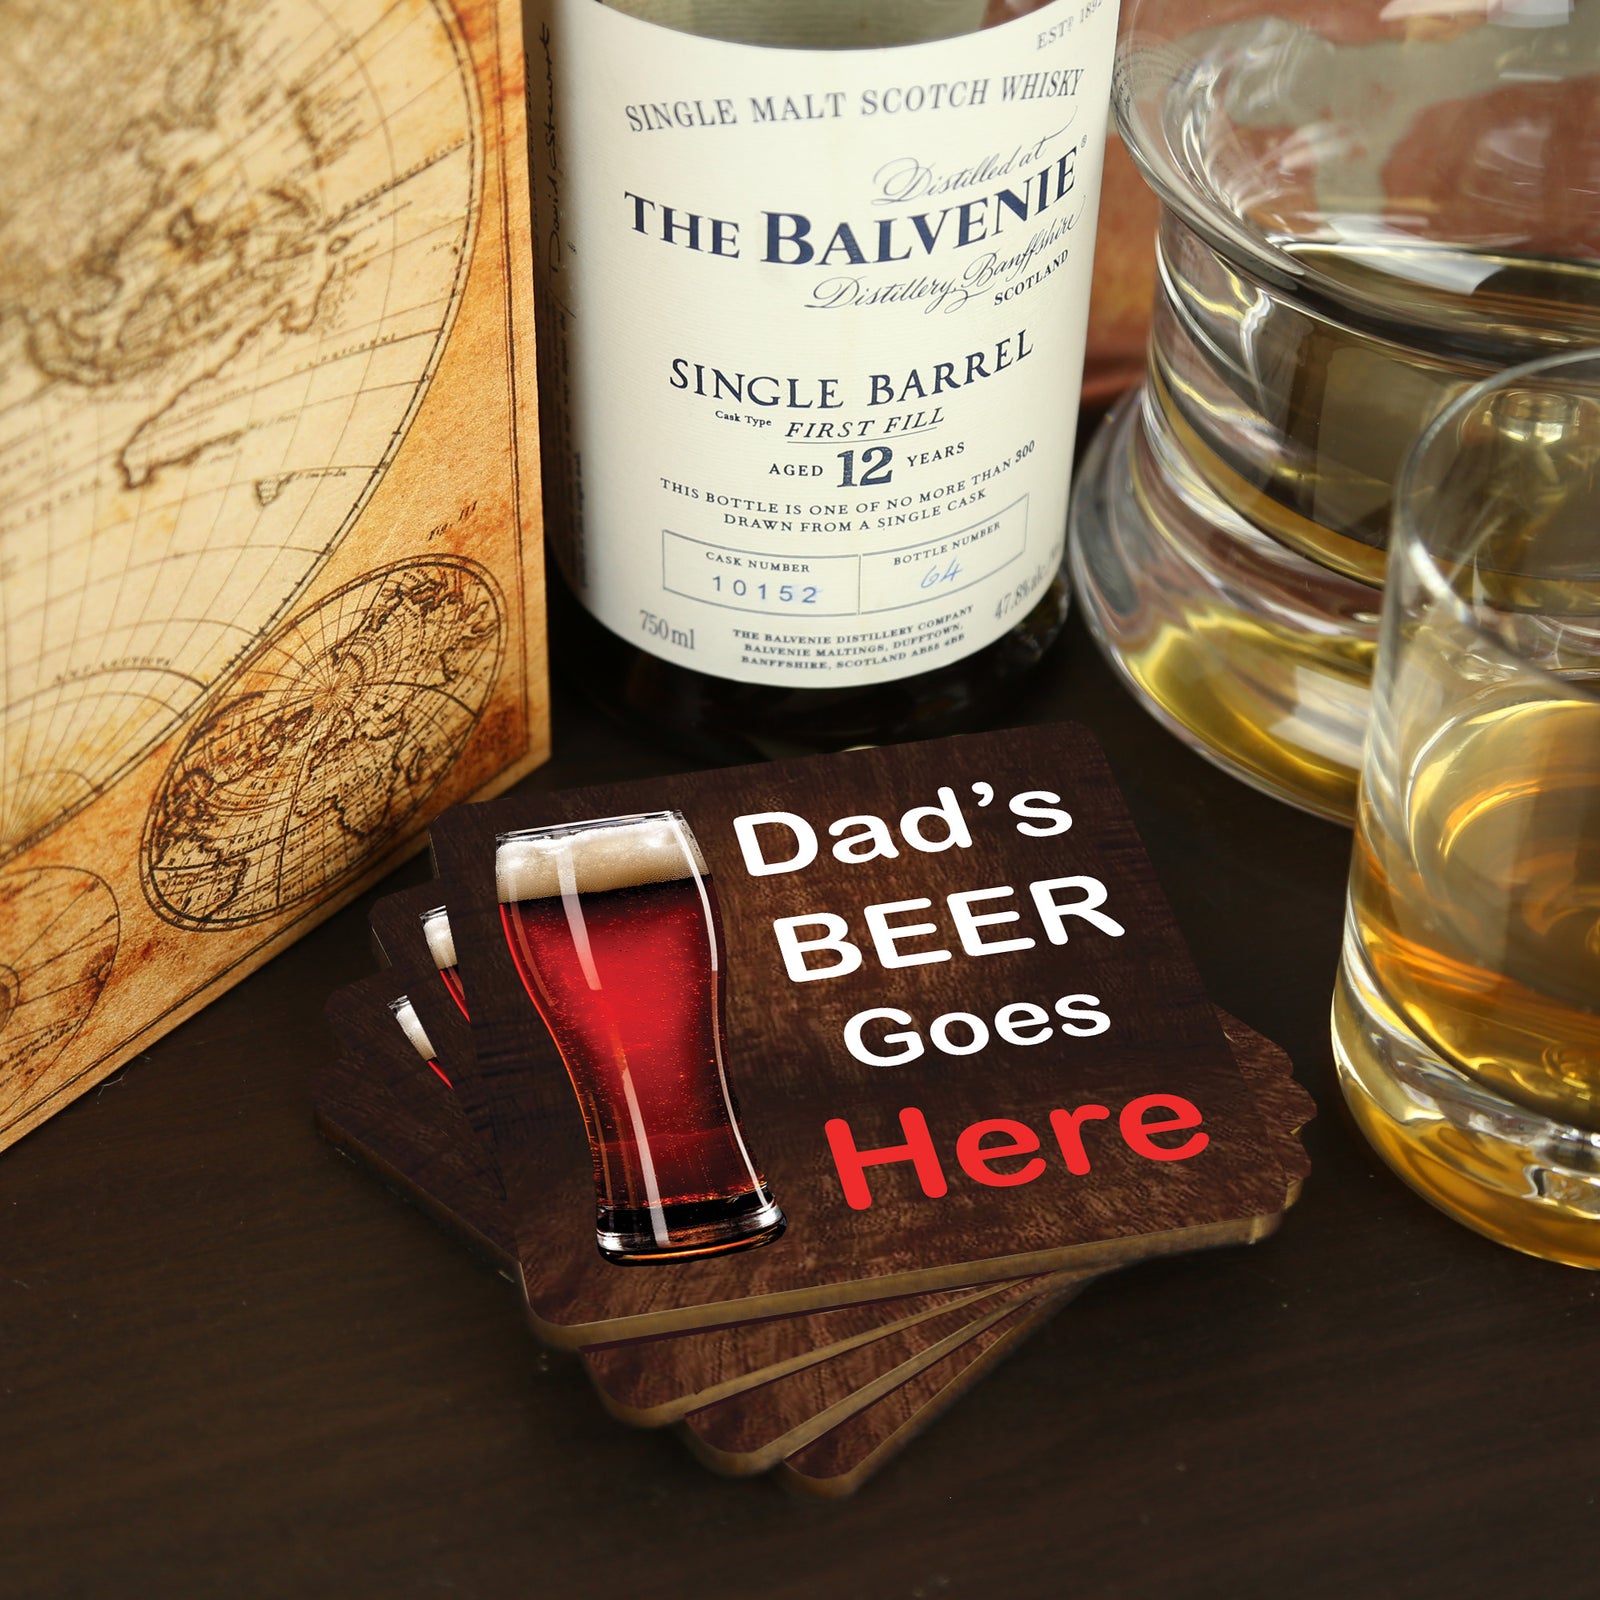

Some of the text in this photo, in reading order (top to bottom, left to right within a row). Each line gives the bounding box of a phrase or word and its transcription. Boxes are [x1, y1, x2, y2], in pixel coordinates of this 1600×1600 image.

[624, 68, 1085, 133] SINGLE MALT SCOTCH WHISKY
[871, 145, 1022, 206] Distilled
[623, 146, 1078, 266] THE BALVENIE
[993, 248, 1069, 307] SCOTLAND
[669, 328, 1034, 410] SINGLE BARREL
[715, 406, 946, 439] Cask Type FIRST FILL
[660, 439, 1036, 516] THIS BOTTLE IS ONE OF NO MORE THAN 300
[768, 441, 966, 488] AGED 12 YEARS
[723, 487, 987, 533] DRAWN FROM A SINGLE CASK
[705, 550, 811, 573] CASK NUMBER
[893, 521, 1001, 566] BOTTLE NUMBER
[711, 574, 823, 604] 10152
[920, 556, 963, 590] 64
[732, 603, 974, 645] THE BALVENIE DISTILLERY COMPANY
[743, 643, 812, 657] BALVENIE
[836, 652, 908, 670] SCOTLAND
[773, 875, 1126, 983] BEER
[843, 993, 1111, 1067] Goes
[824, 1093, 1210, 1211] Here
